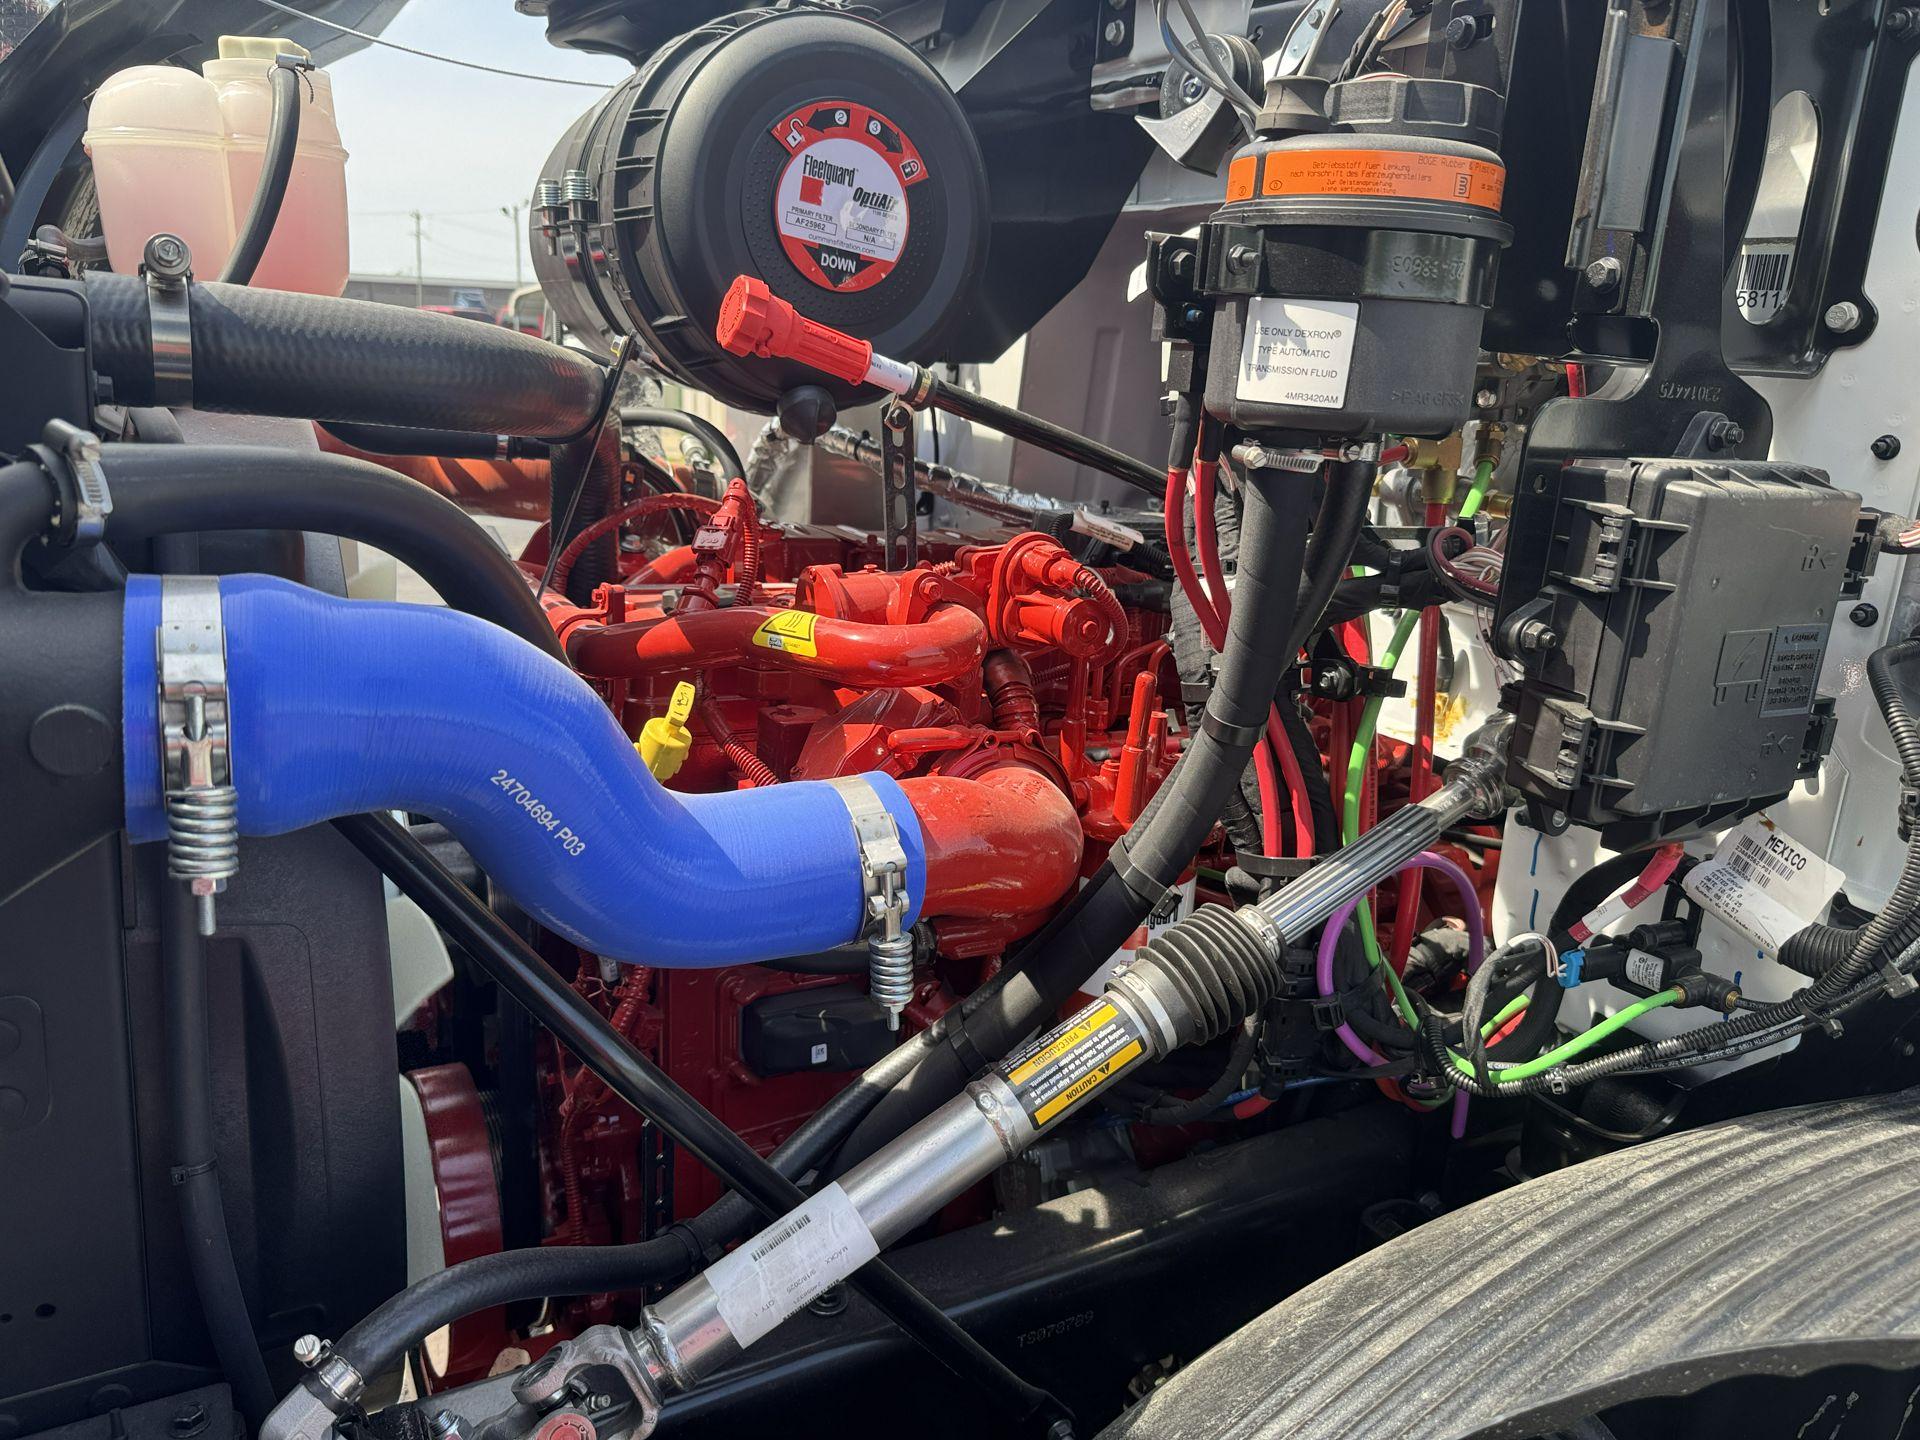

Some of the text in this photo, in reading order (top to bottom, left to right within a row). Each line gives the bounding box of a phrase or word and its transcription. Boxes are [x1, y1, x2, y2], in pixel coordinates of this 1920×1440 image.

[803, 154, 857, 188] Fleetguard
[853, 187, 898, 211] OptiAir
[792, 206, 833, 222] PRIMARY FILTER
[796, 218, 826, 231] AF25962
[808, 234, 875, 255] cumminsfiltration.com
[864, 234, 876, 244] N/A
[821, 253, 856, 273] DOWN
[1736, 290, 1784, 309] 5811
[1256, 326, 1269, 336] USE
[1272, 328, 1293, 336] ONLY
[1258, 346, 1330, 358] TYPE AUTOMATIC
[1248, 364, 1338, 378] TRANSMISSION FLUID
[1285, 392, 1339, 404] 4MR3420AM
[490, 769, 586, 856] 24704694 P03
[1766, 834, 1807, 870] MEXICO
[1710, 872, 1727, 887] TESTED
[1086, 1052, 1104, 1067] damage
[1057, 1077, 1069, 1088] Align
[1065, 1074, 1097, 1100] CAUTION
